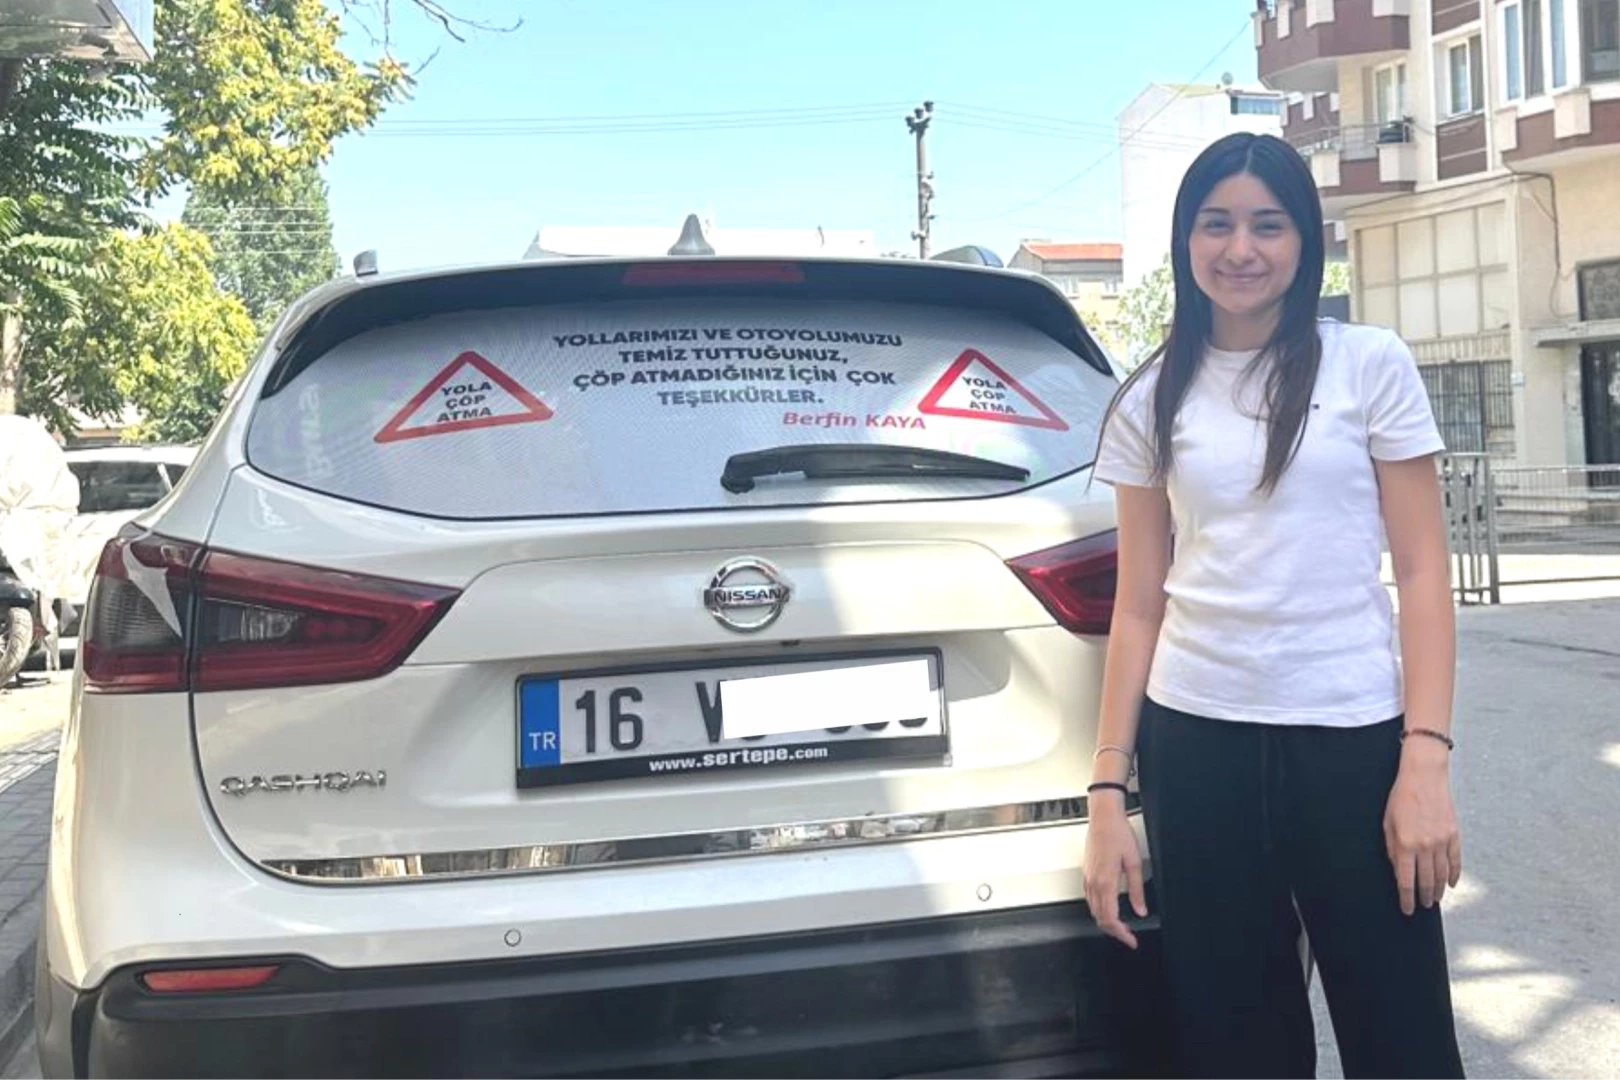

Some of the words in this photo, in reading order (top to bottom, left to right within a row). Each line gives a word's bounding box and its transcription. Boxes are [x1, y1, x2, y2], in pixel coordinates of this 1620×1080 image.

[554, 328, 698, 348] YOLLARIMIZI
[703, 328, 733, 341] VE
[737, 328, 903, 347] OTOYOLUMUZU
[618, 345, 688, 363] TEMİZ
[691, 345, 848, 364] TUTTUĞUNUZ,
[573, 369, 626, 391] ÇÖP
[631, 366, 786, 385] ATMADIĞINIZ
[791, 365, 837, 385] İÇİN
[846, 370, 897, 387] ÇOK
[962, 376, 1008, 390] YOLA
[441, 381, 493, 396] YOLA
[657, 387, 825, 408] TEŞEKKÜRLER.
[446, 394, 486, 410] ÇÖP
[969, 401, 1018, 414] ATMA
[437, 407, 492, 423] ATMA
[783, 411, 857, 429] Berfin
[865, 413, 926, 430] KAYA
[714, 588, 781, 603] NISSAN
[574, 686, 644, 754] 16
[529, 732, 556, 750] TR
[649, 745, 829, 772] www.sertepe.com
[220, 769, 387, 797] QASHQAI
